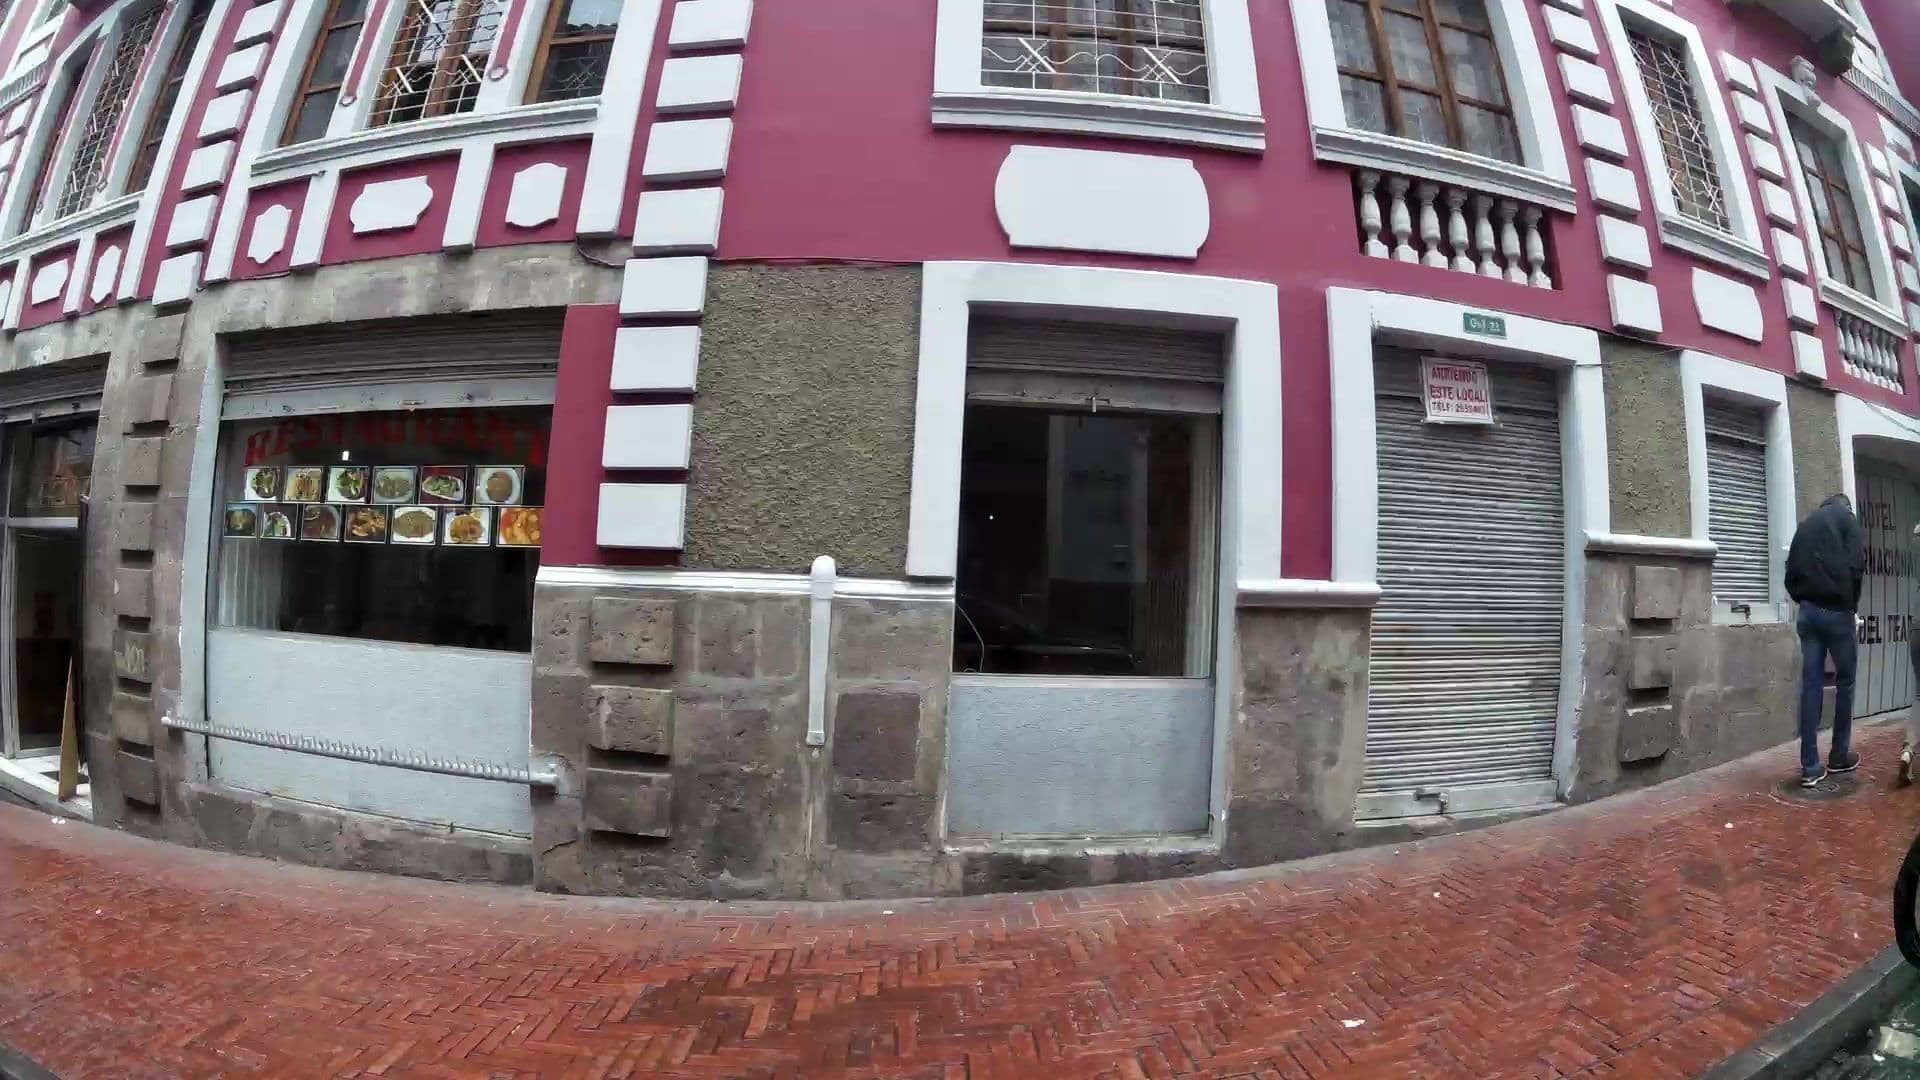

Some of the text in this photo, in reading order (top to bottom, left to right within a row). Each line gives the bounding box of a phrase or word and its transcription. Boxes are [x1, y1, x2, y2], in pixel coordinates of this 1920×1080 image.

[1430, 385, 1487, 403] ESTE LOCAL
[1858, 500, 1896, 530] HOTEL
[1858, 615, 1881, 644] DEL
